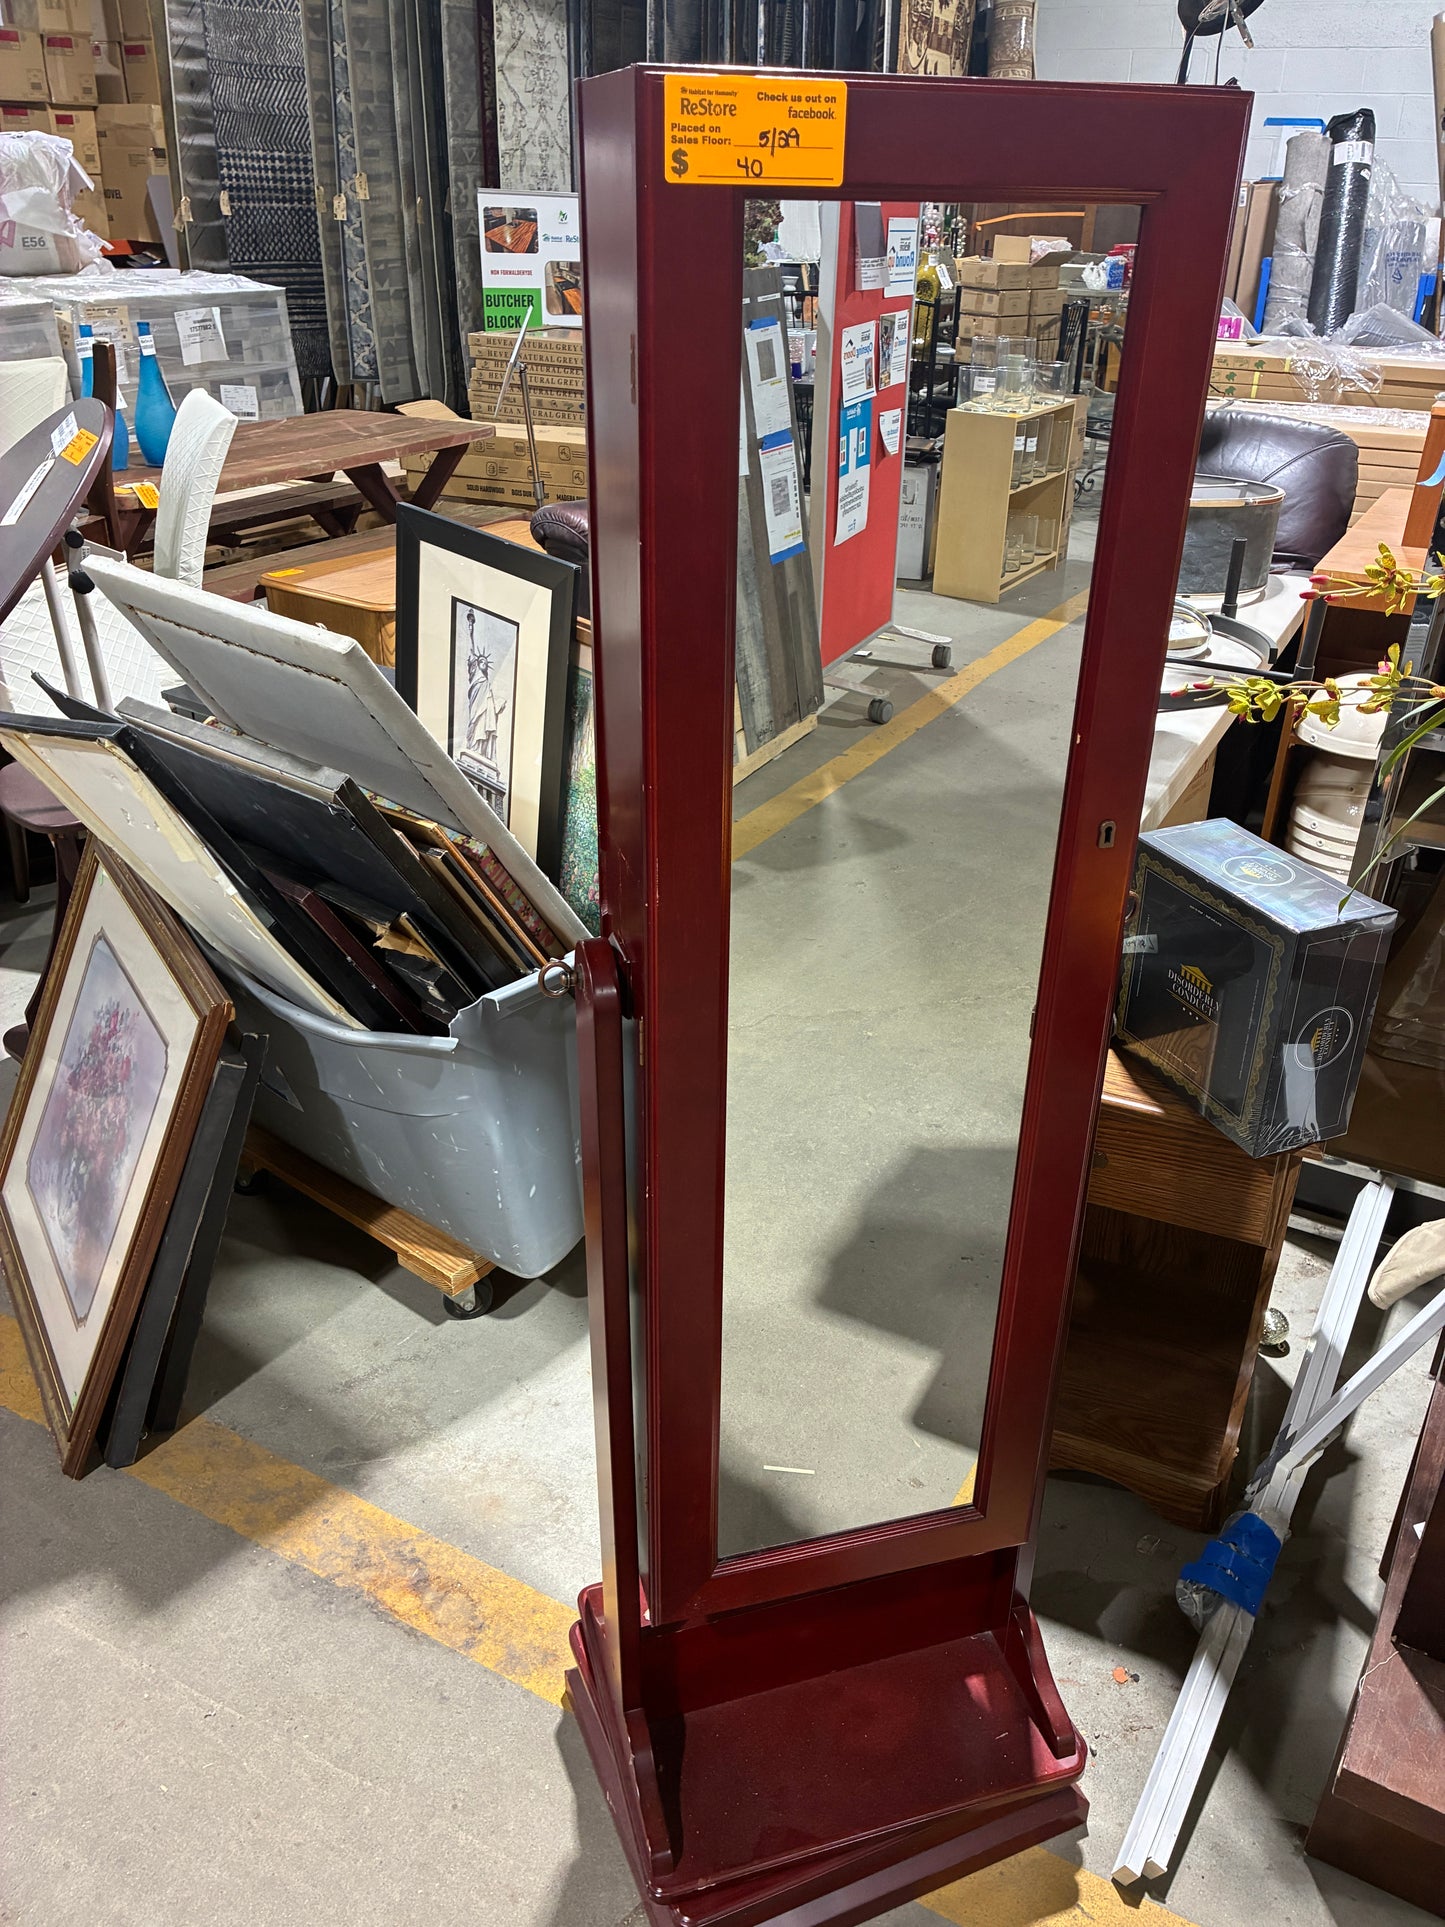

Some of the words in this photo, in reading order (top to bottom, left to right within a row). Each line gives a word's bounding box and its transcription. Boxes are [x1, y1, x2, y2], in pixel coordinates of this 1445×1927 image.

[688, 88, 706, 96] Habitat
[714, 89, 738, 97] Humanity
[757, 92, 788, 102] Check
[790, 95, 802, 103] us
[804, 94, 822, 104] out
[824, 96, 836, 104] on
[680, 98, 737, 116] ReStore
[671, 122, 706, 133] Placed
[708, 124, 721, 134] on
[671, 134, 698, 144] Sales
[702, 136, 732, 145] Floor:
[759, 127, 800, 157] 5/29
[670, 148, 689, 178] $
[737, 156, 763, 178] 40
[22, 236, 46, 248] E56
[486, 294, 534, 308] BUTCHER
[487, 314, 522, 328] BLOCK
[486, 338, 514, 346] HEVEA
[556, 344, 578, 352] GREY
[557, 378, 580, 387] GREY
[556, 389, 579, 398] GREY
[556, 412, 578, 420] GREY
[480, 486, 504, 494] HARDWOOD
[1168, 969, 1218, 1012] DISORDERLY
[1172, 982, 1212, 1016] CONDUCT
